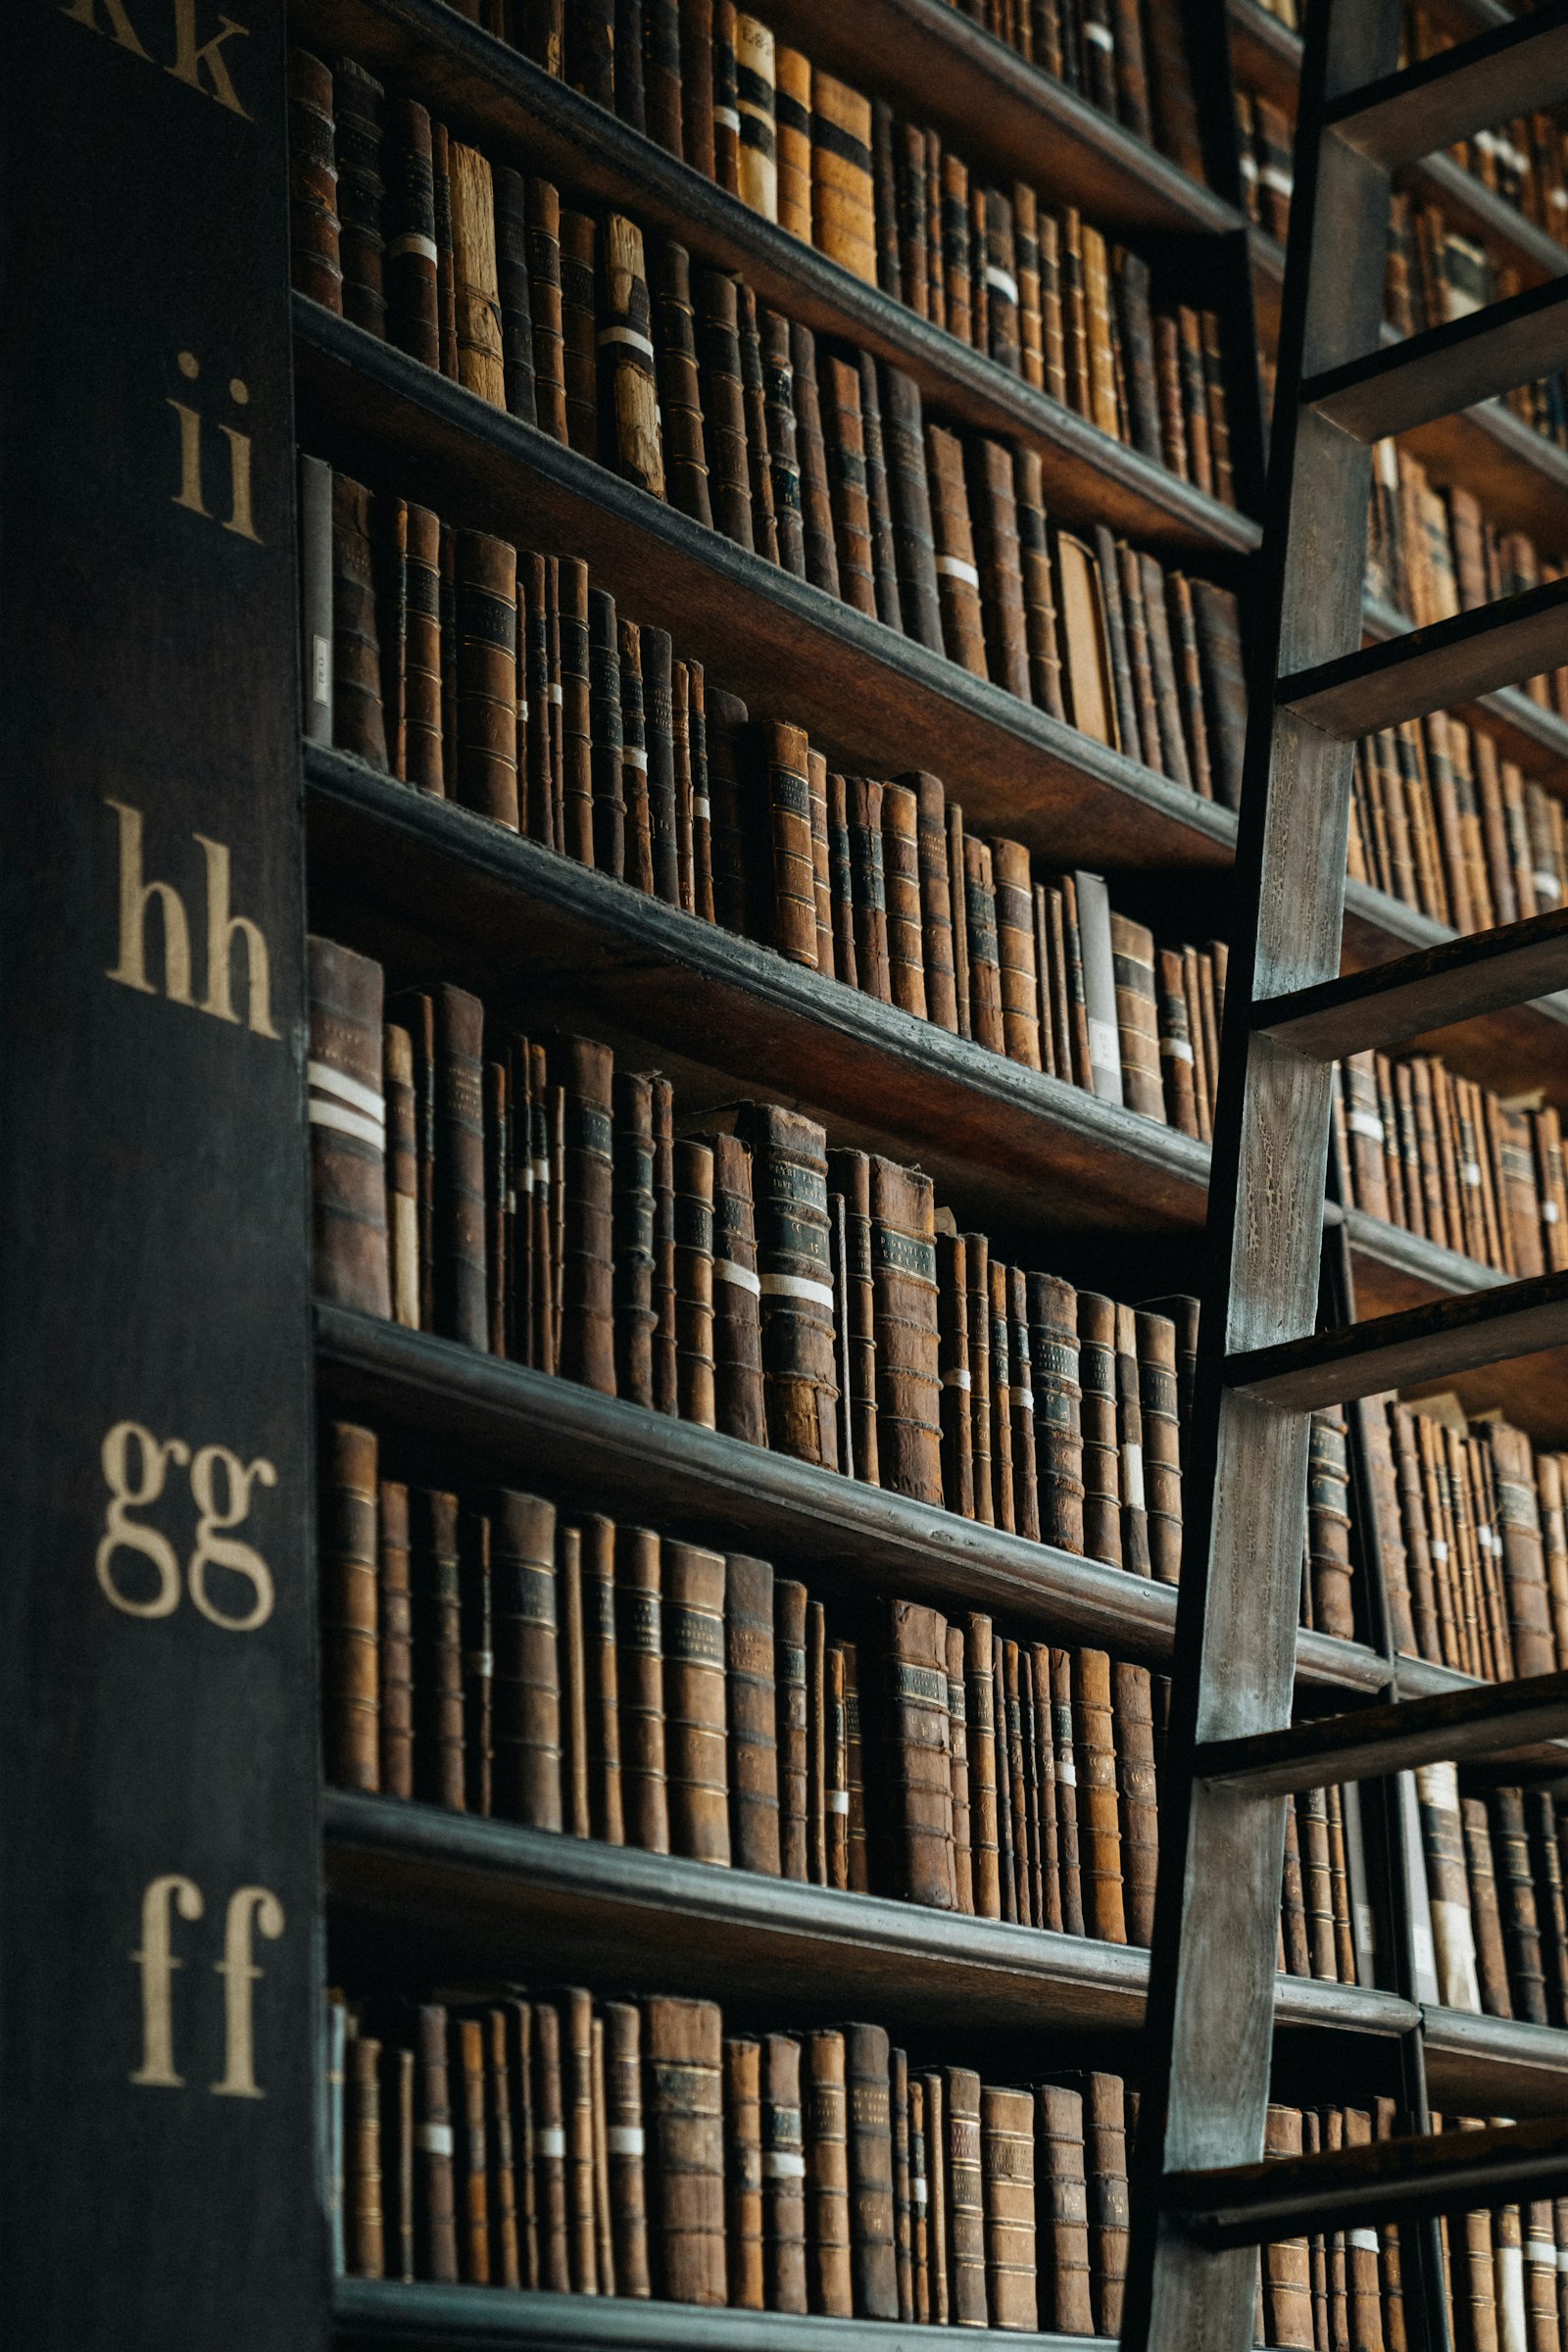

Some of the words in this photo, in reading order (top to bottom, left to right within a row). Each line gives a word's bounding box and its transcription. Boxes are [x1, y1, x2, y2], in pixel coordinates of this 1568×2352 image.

[171, 351, 264, 545] ii
[104, 796, 281, 1040] hh
[95, 1420, 278, 1631] gg
[132, 1874, 284, 2098] ff
